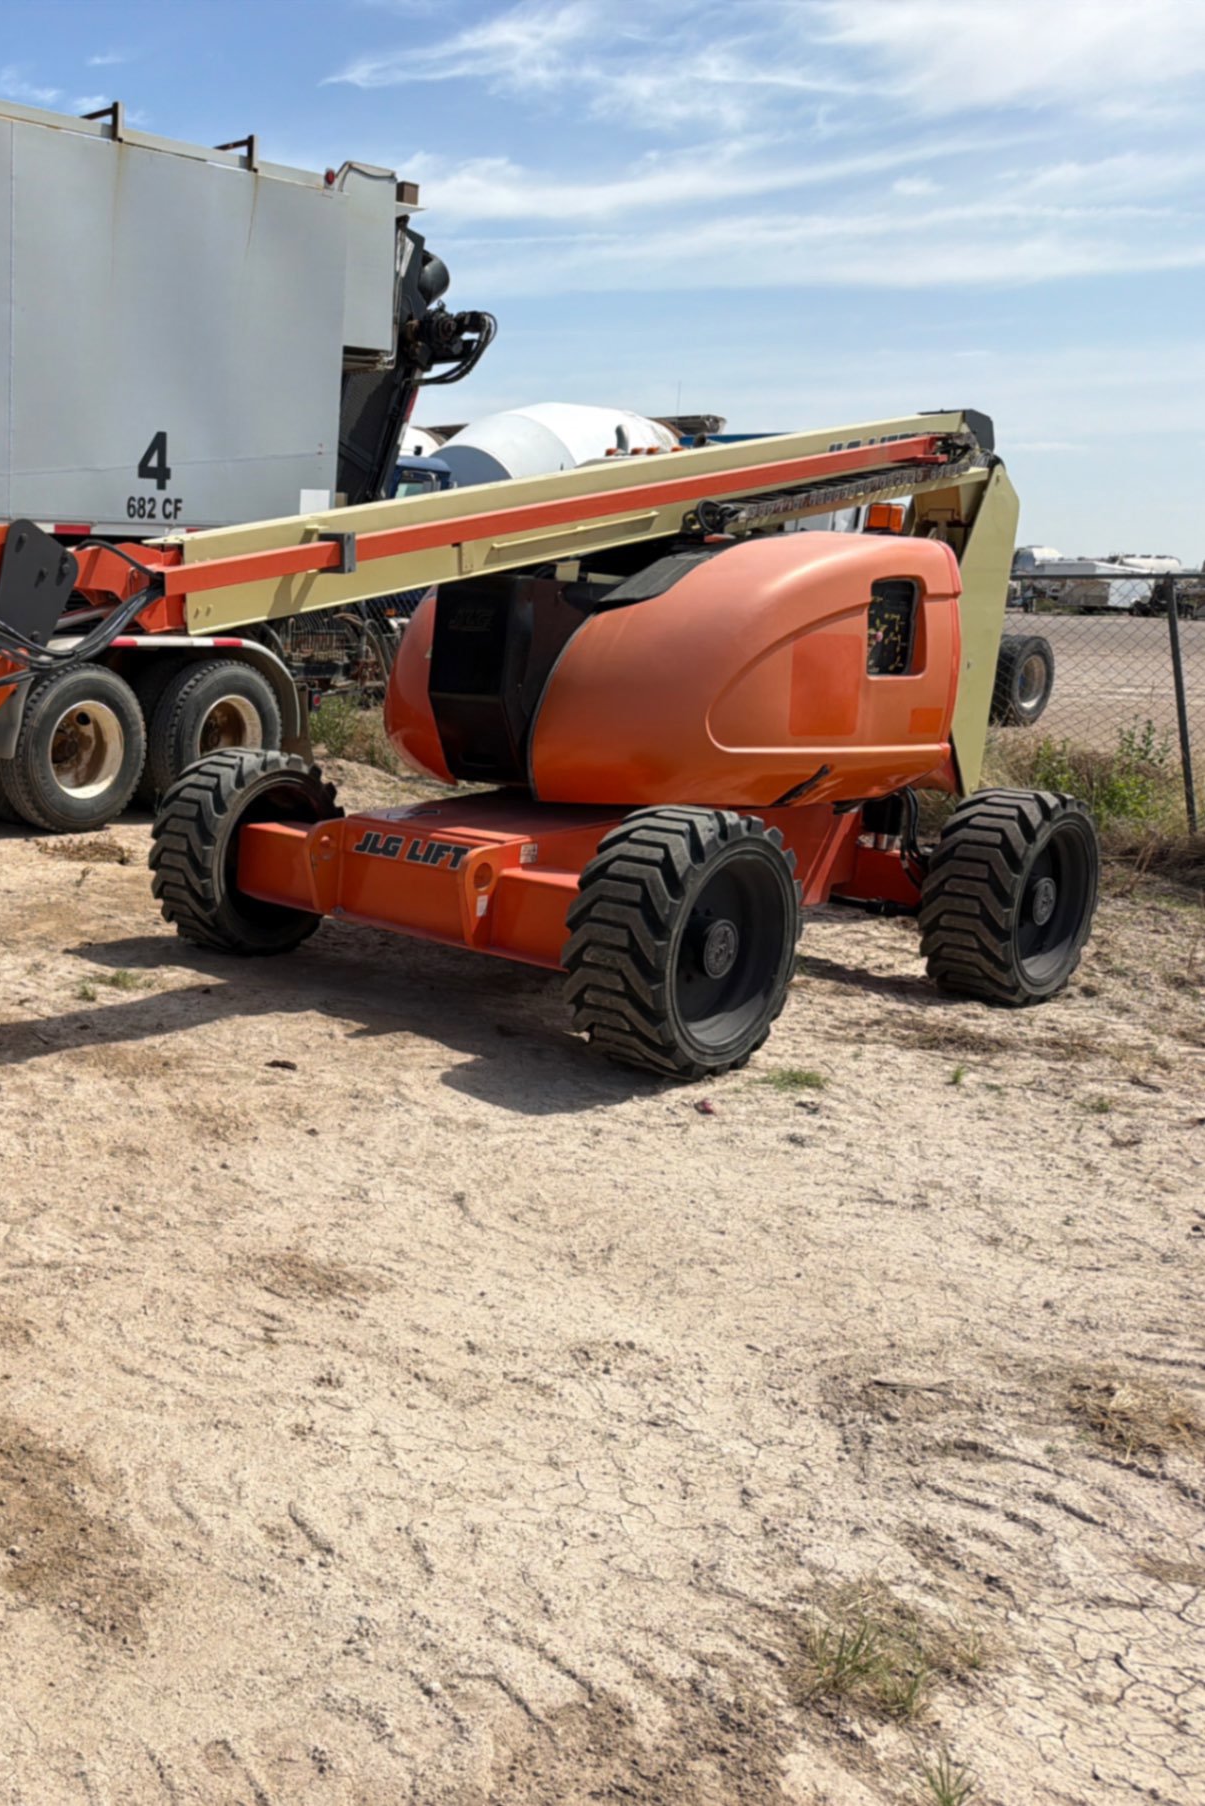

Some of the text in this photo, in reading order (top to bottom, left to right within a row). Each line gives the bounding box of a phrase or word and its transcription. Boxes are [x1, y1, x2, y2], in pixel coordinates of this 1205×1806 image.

[137, 430, 171, 491] 4
[126, 496, 183, 520] 682 CF
[354, 832, 471, 870] JLG LIFT
